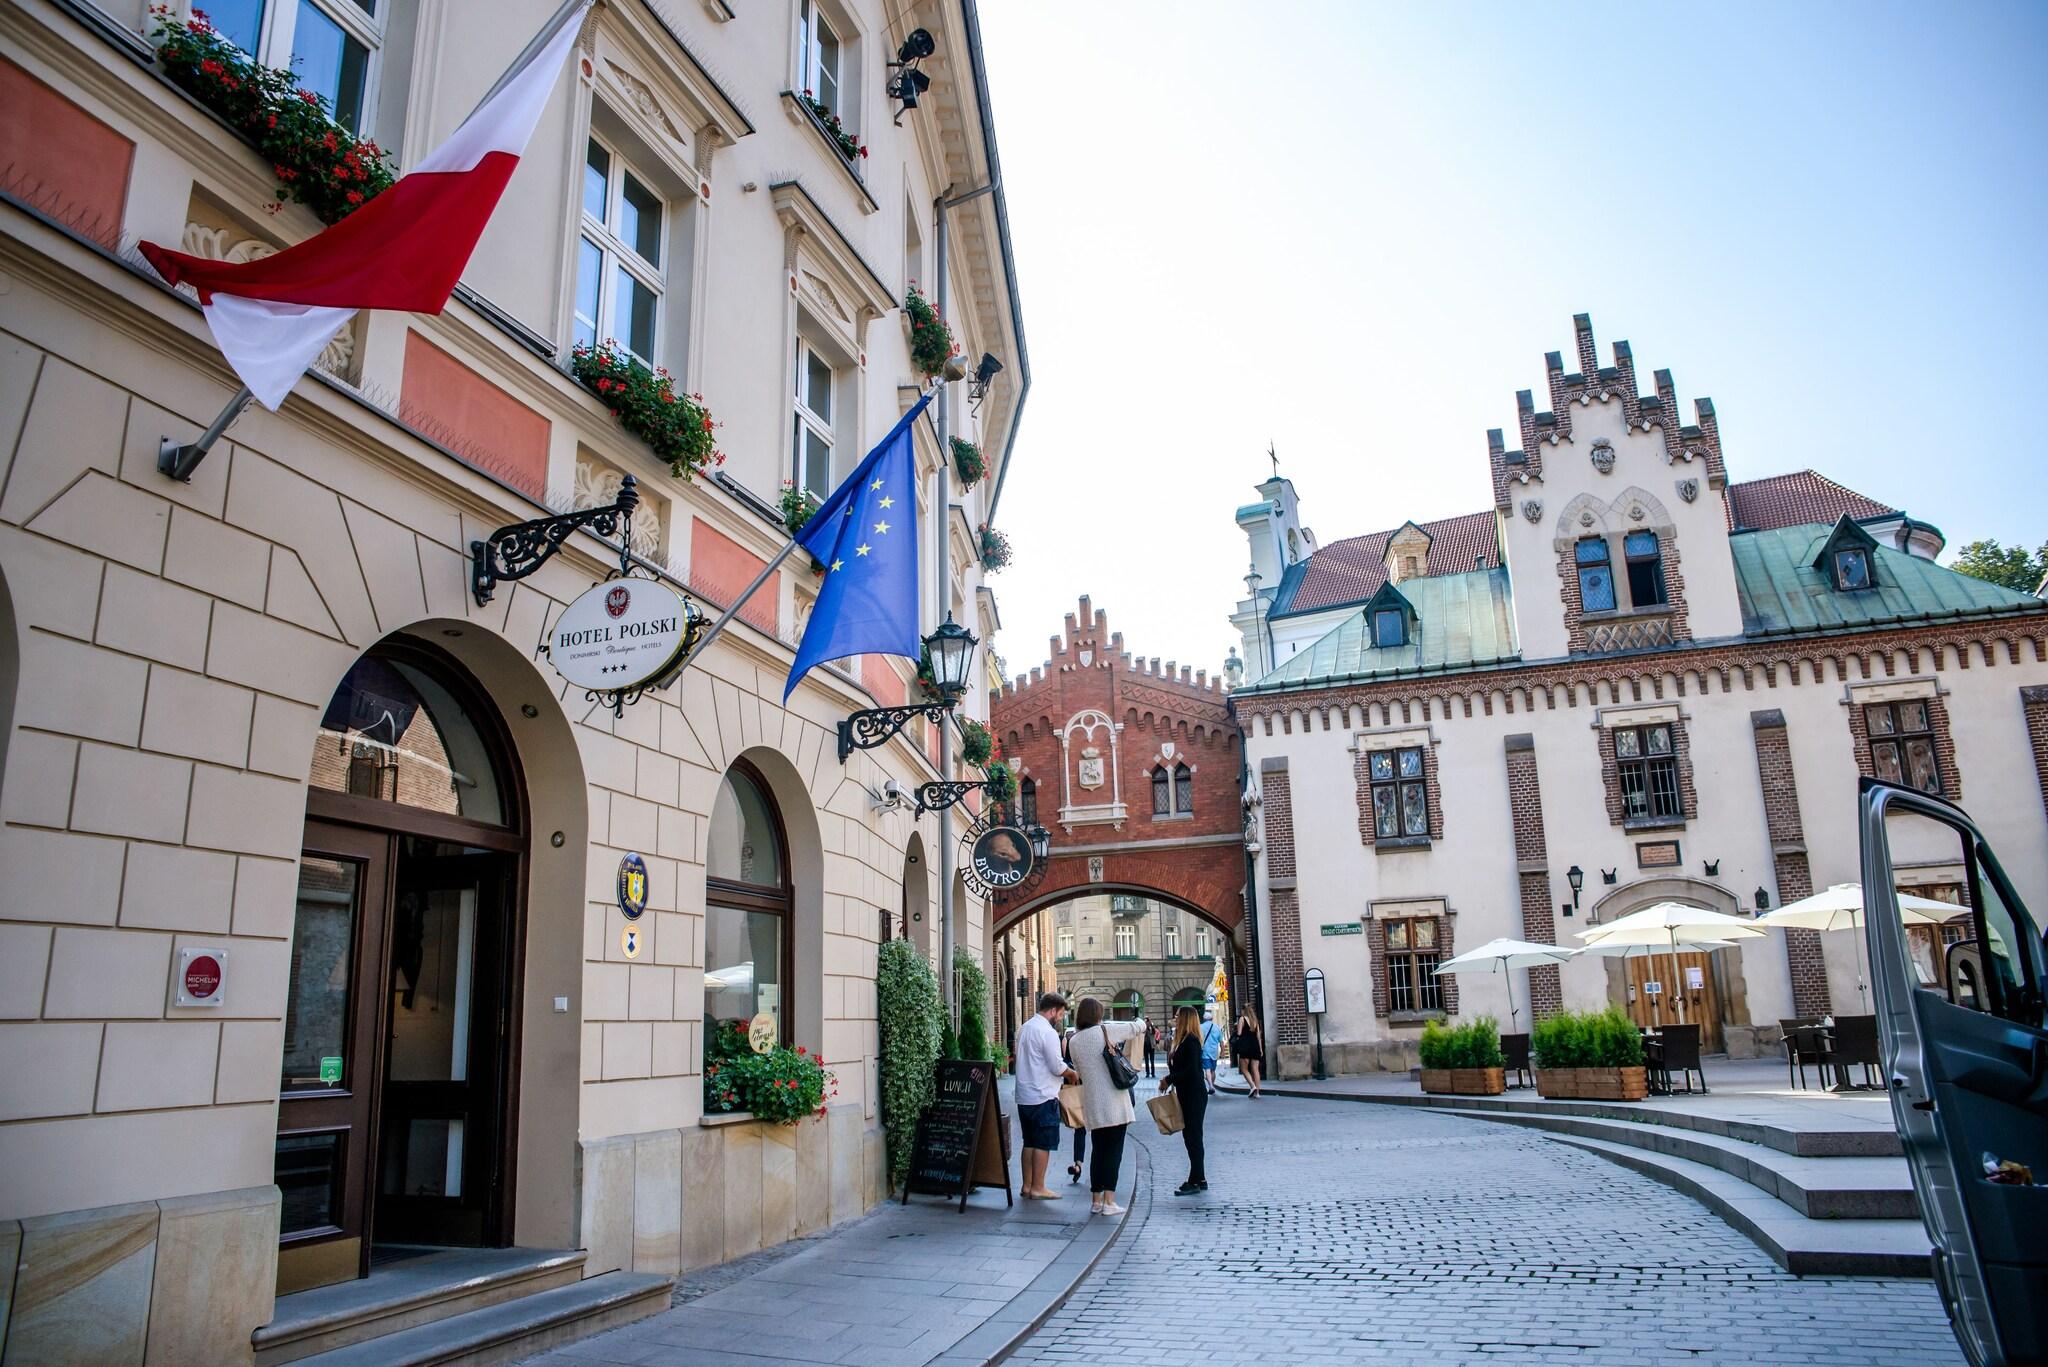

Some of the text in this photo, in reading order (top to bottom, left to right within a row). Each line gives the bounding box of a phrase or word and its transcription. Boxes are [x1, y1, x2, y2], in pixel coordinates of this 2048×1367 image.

[560, 617, 677, 648] HOTEL POLSKI
[641, 642, 662, 650] HOTELS
[976, 857, 1021, 885] BISTRO
[187, 976, 218, 984] MICHELIN
[944, 1080, 971, 1094] LUNCH
